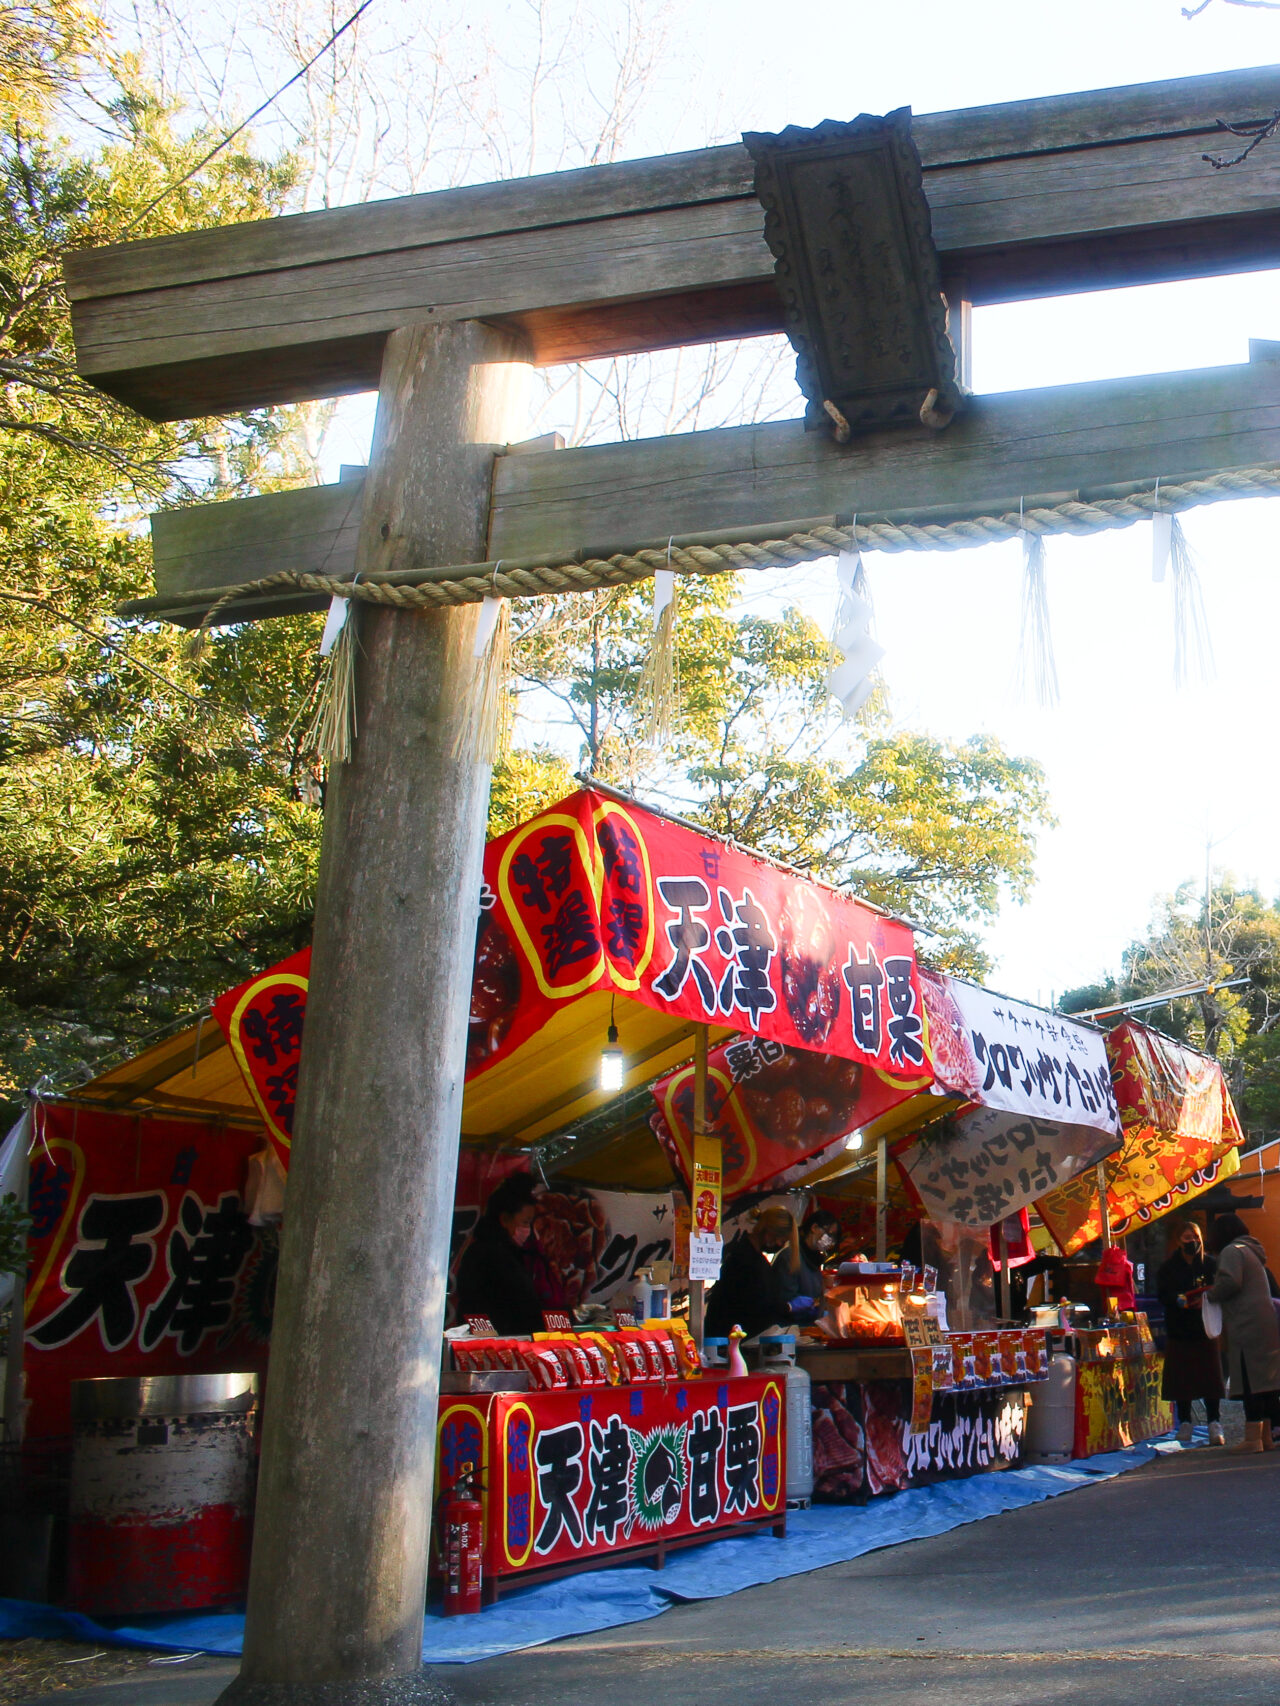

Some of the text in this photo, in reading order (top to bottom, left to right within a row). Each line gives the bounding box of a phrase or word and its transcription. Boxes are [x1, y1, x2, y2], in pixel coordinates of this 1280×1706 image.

[652, 876, 924, 1067] 天津 甘栗
[534, 1414, 633, 1555] 天津
[687, 1402, 761, 1528] 甘栗
